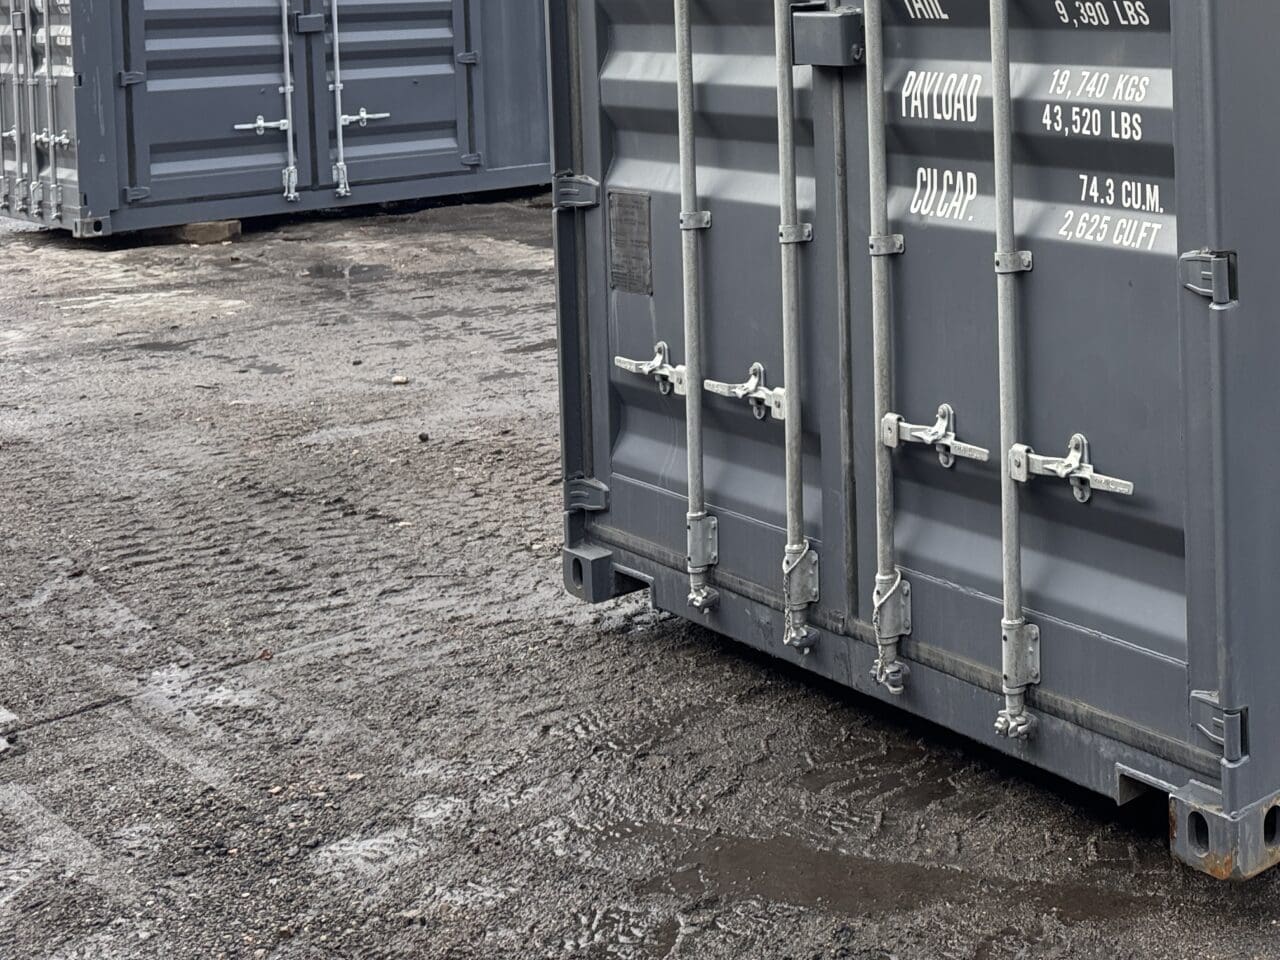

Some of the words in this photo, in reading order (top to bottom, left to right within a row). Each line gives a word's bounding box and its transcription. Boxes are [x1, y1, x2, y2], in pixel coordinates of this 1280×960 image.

[1054, 0, 1110, 28] 9,390
[1113, 0, 1150, 26] LBS
[901, 70, 982, 122] PAYLOAD
[1049, 68, 1110, 101] 19,740
[1112, 74, 1149, 102] KGS
[1042, 103, 1102, 137] 43,520
[1110, 110, 1143, 141] LBS
[909, 167, 977, 222] CU.CAP.
[1079, 174, 1115, 206] 74.3
[1121, 180, 1164, 214] CU.M.
[1058, 210, 1110, 241] 2,625
[1112, 218, 1162, 250] CU.FT
